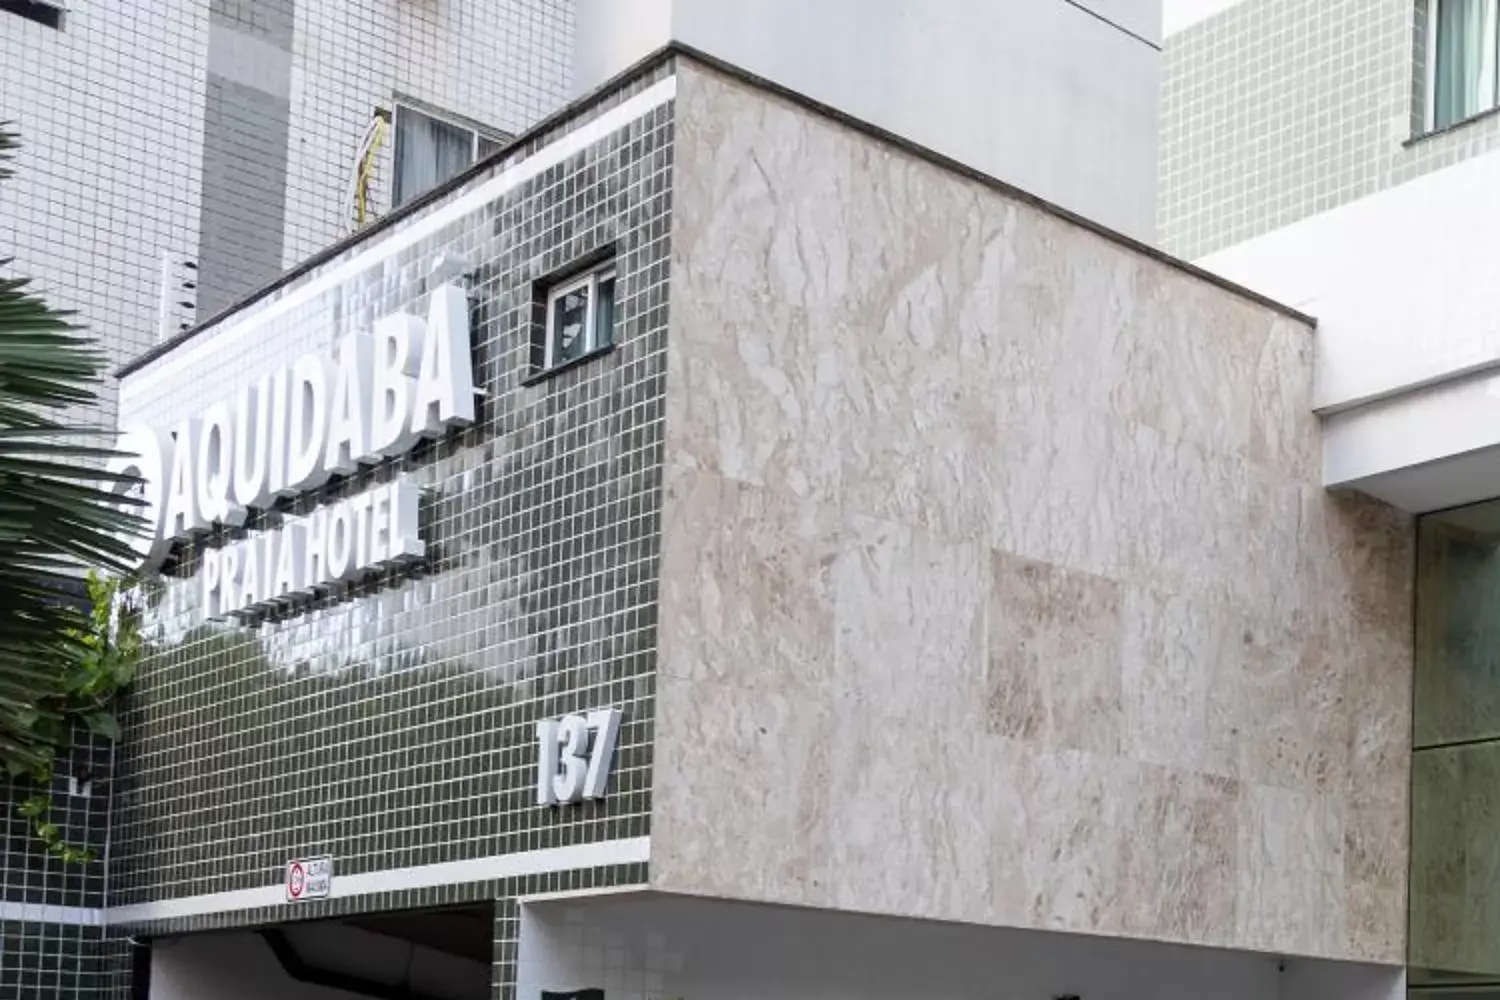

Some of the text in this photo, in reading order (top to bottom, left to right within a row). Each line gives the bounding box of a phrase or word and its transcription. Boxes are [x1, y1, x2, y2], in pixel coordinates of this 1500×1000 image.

[203, 473, 425, 619] PRAIA HOTEL
[536, 708, 622, 805] 137
